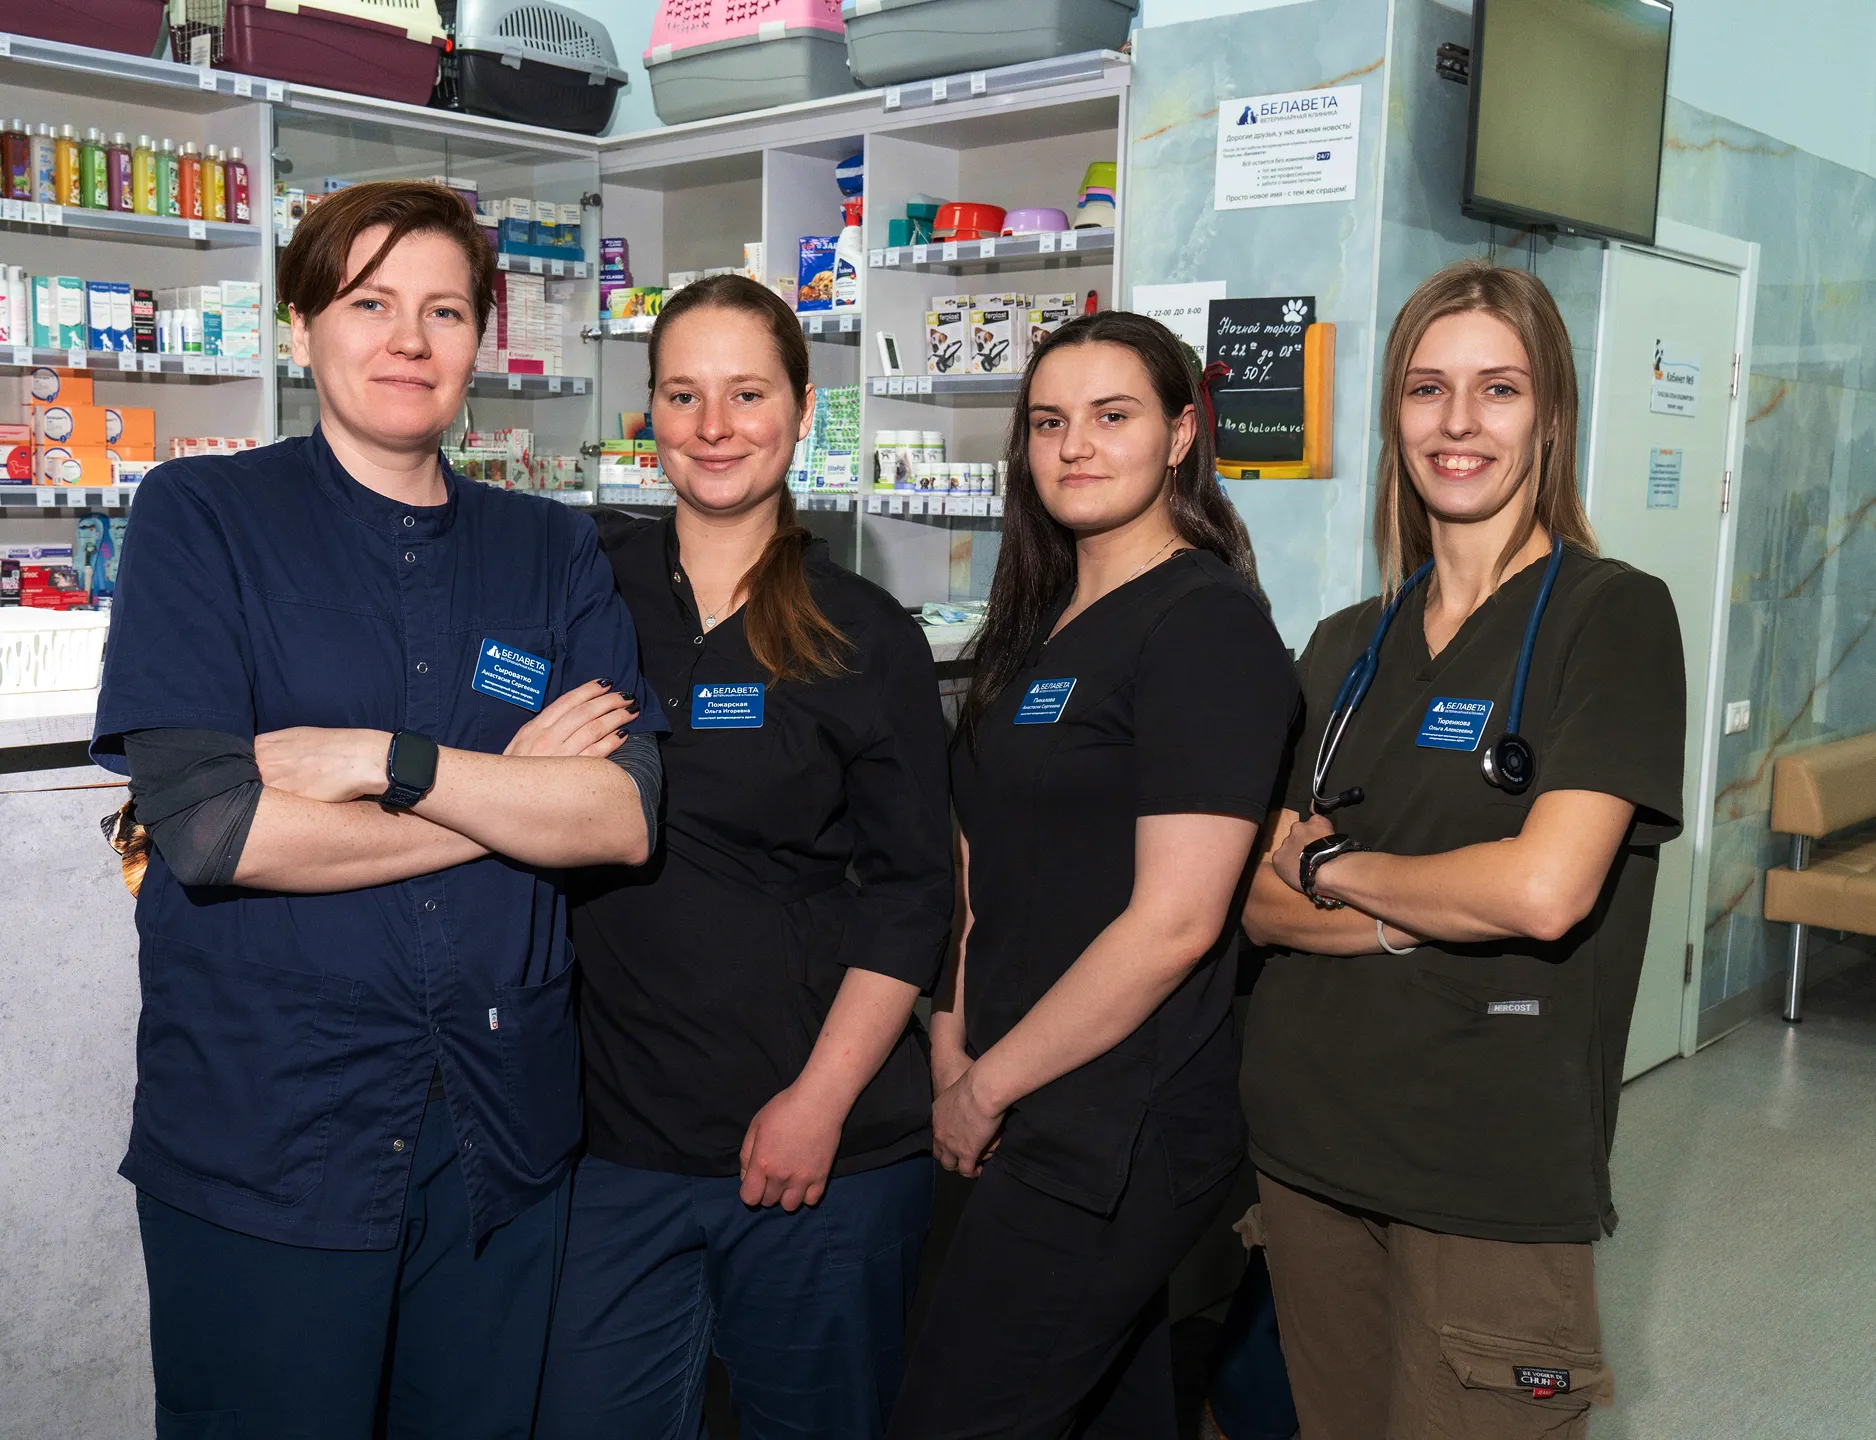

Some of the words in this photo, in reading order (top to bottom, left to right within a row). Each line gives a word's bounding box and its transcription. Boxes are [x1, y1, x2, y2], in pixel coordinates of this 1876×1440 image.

[1261, 96, 1338, 116] БЕЛАВЕТА
[1260, 114, 1307, 124] ВЕТЕРИНАРНАЯ
[1308, 110, 1338, 118] КЛИНИКА
[1226, 133, 1253, 143] Дорогие
[1254, 131, 1278, 141] друзья,
[1323, 123, 1352, 131] новость!
[1317, 153, 1330, 161] 24/7
[1226, 195, 1248, 203] Просто
[1316, 186, 1347, 195] сердцем!
[939, 313, 960, 321] ferplast
[985, 312, 1008, 320] ferplast
[1174, 308, 1185, 316] ДО
[1217, 316, 1260, 335] Ночной
[1264, 324, 1302, 337] тариф
[1257, 349, 1273, 365] до
[502, 649, 546, 672] БЕЛАВЕТА
[482, 669, 511, 684] Анастасия
[511, 680, 540, 695] Сергеевна
[494, 664, 532, 684] Сыроватко
[1446, 702, 1486, 712] БЕЛАВЕТА
[1438, 717, 1471, 727] Тюренкова
